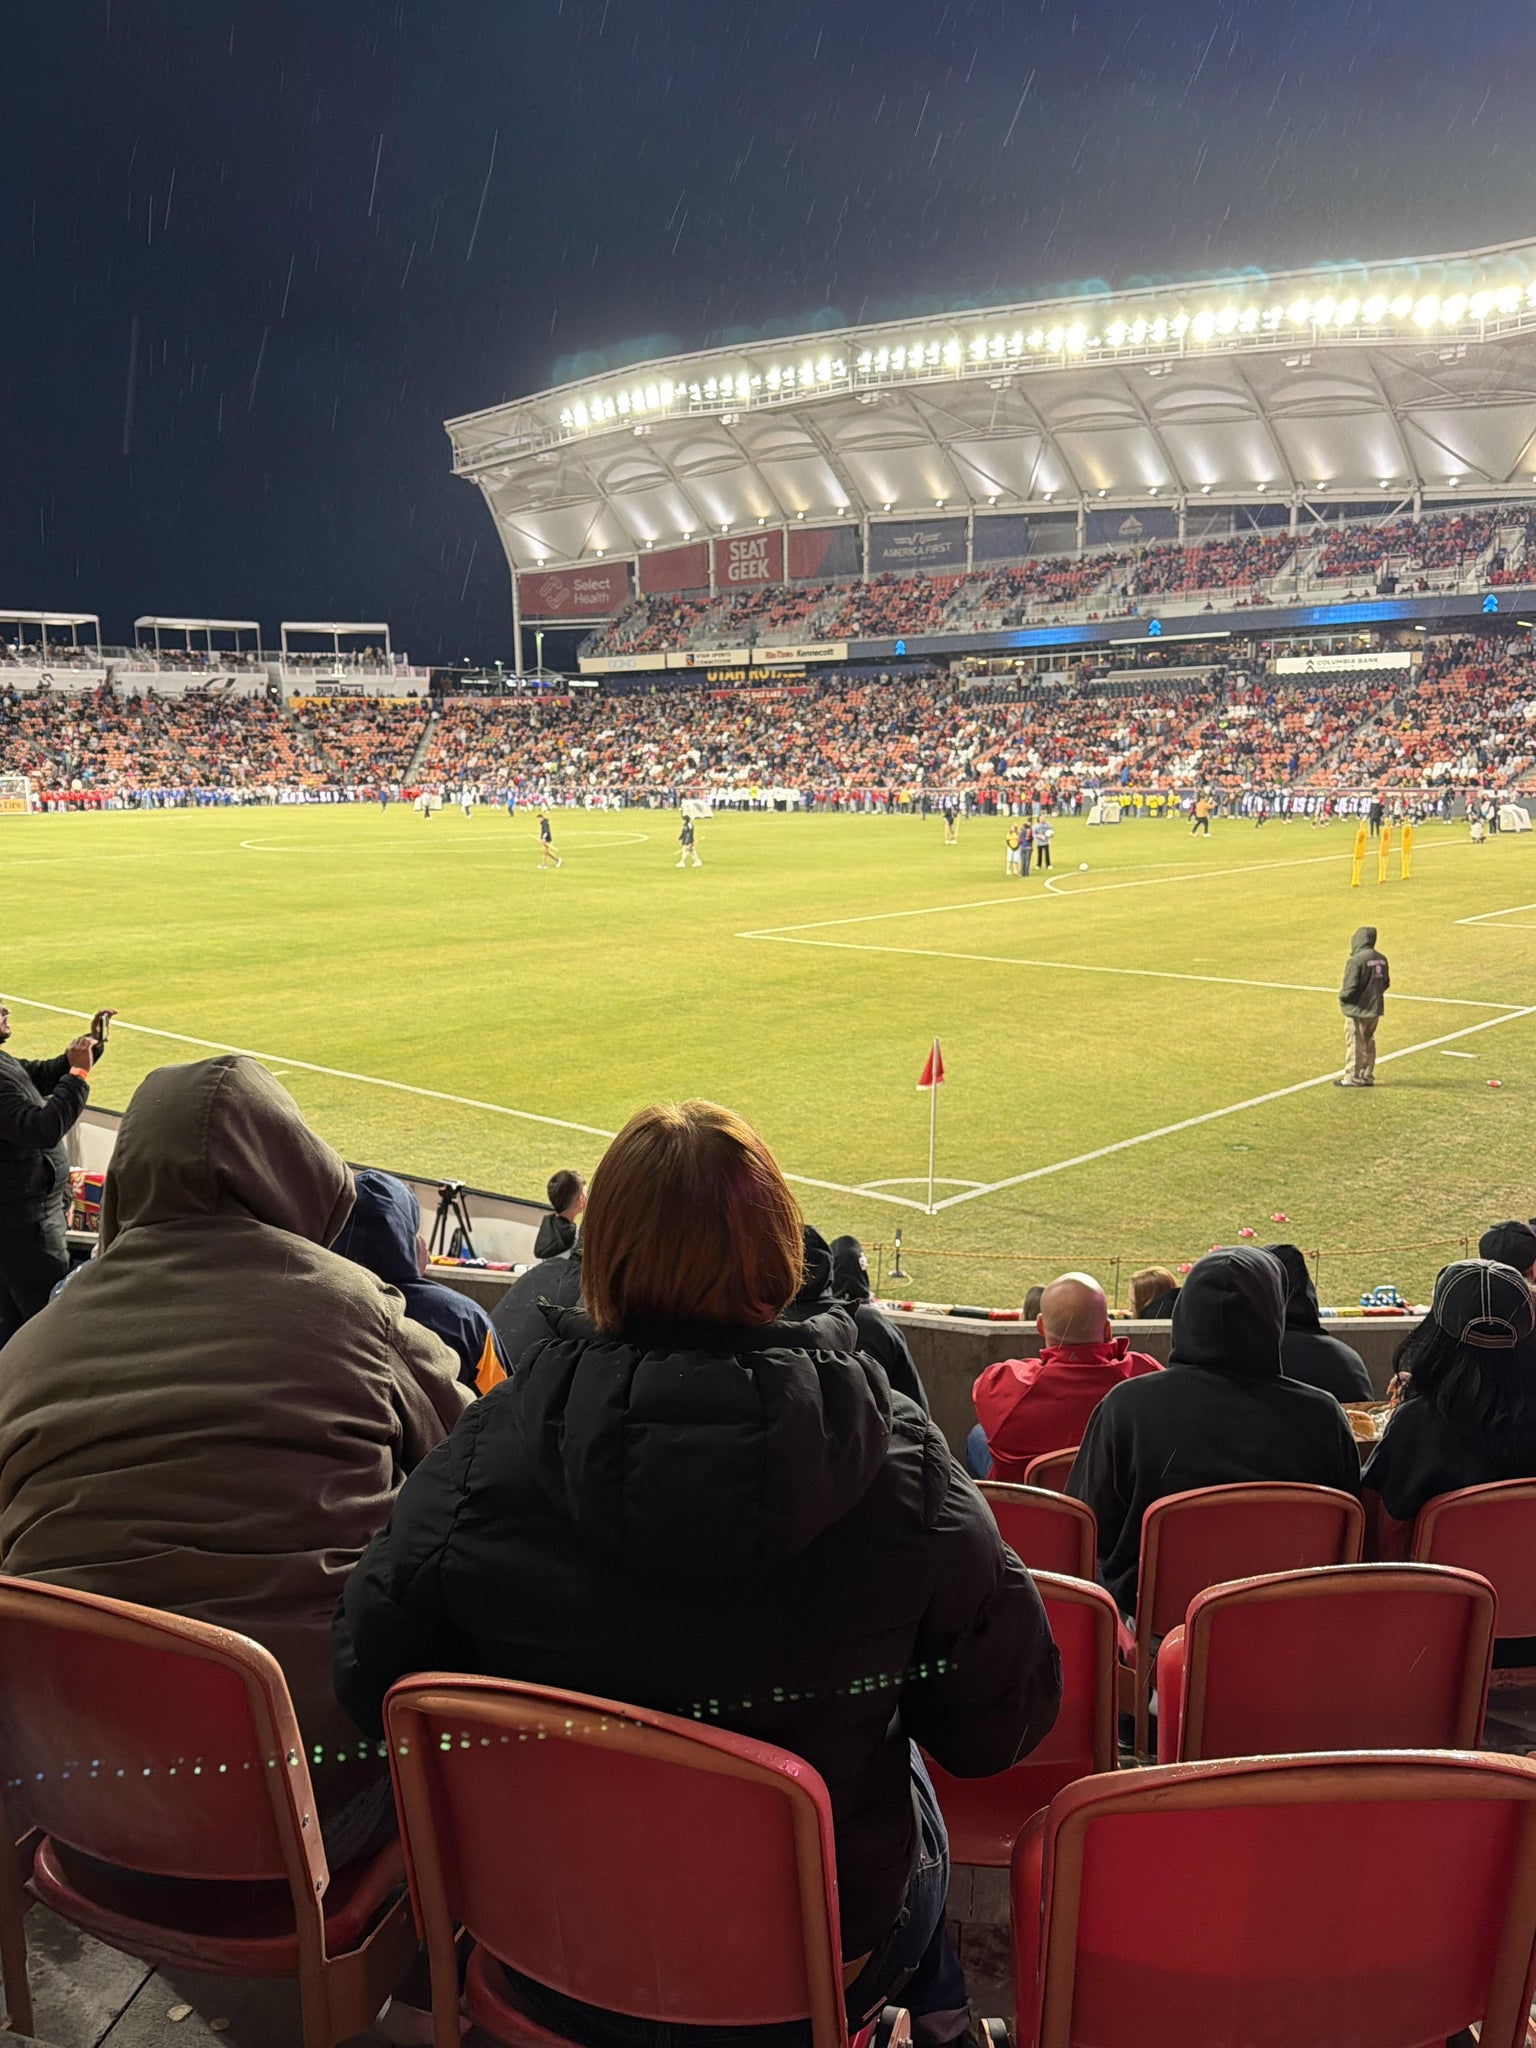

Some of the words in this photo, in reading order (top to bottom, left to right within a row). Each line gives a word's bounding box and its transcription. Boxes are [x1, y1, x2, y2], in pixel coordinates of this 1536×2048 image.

[729, 537, 768, 561] SEAT
[883, 545, 924, 558] AMERICA
[925, 542, 953, 555] FIRST
[728, 558, 771, 581] GEEK
[573, 578, 611, 591] Select
[573, 591, 610, 605] Health
[796, 648, 835, 658] Kennecott
[1317, 658, 1355, 666] COLUMBIA
[706, 669, 746, 682] UTAH
